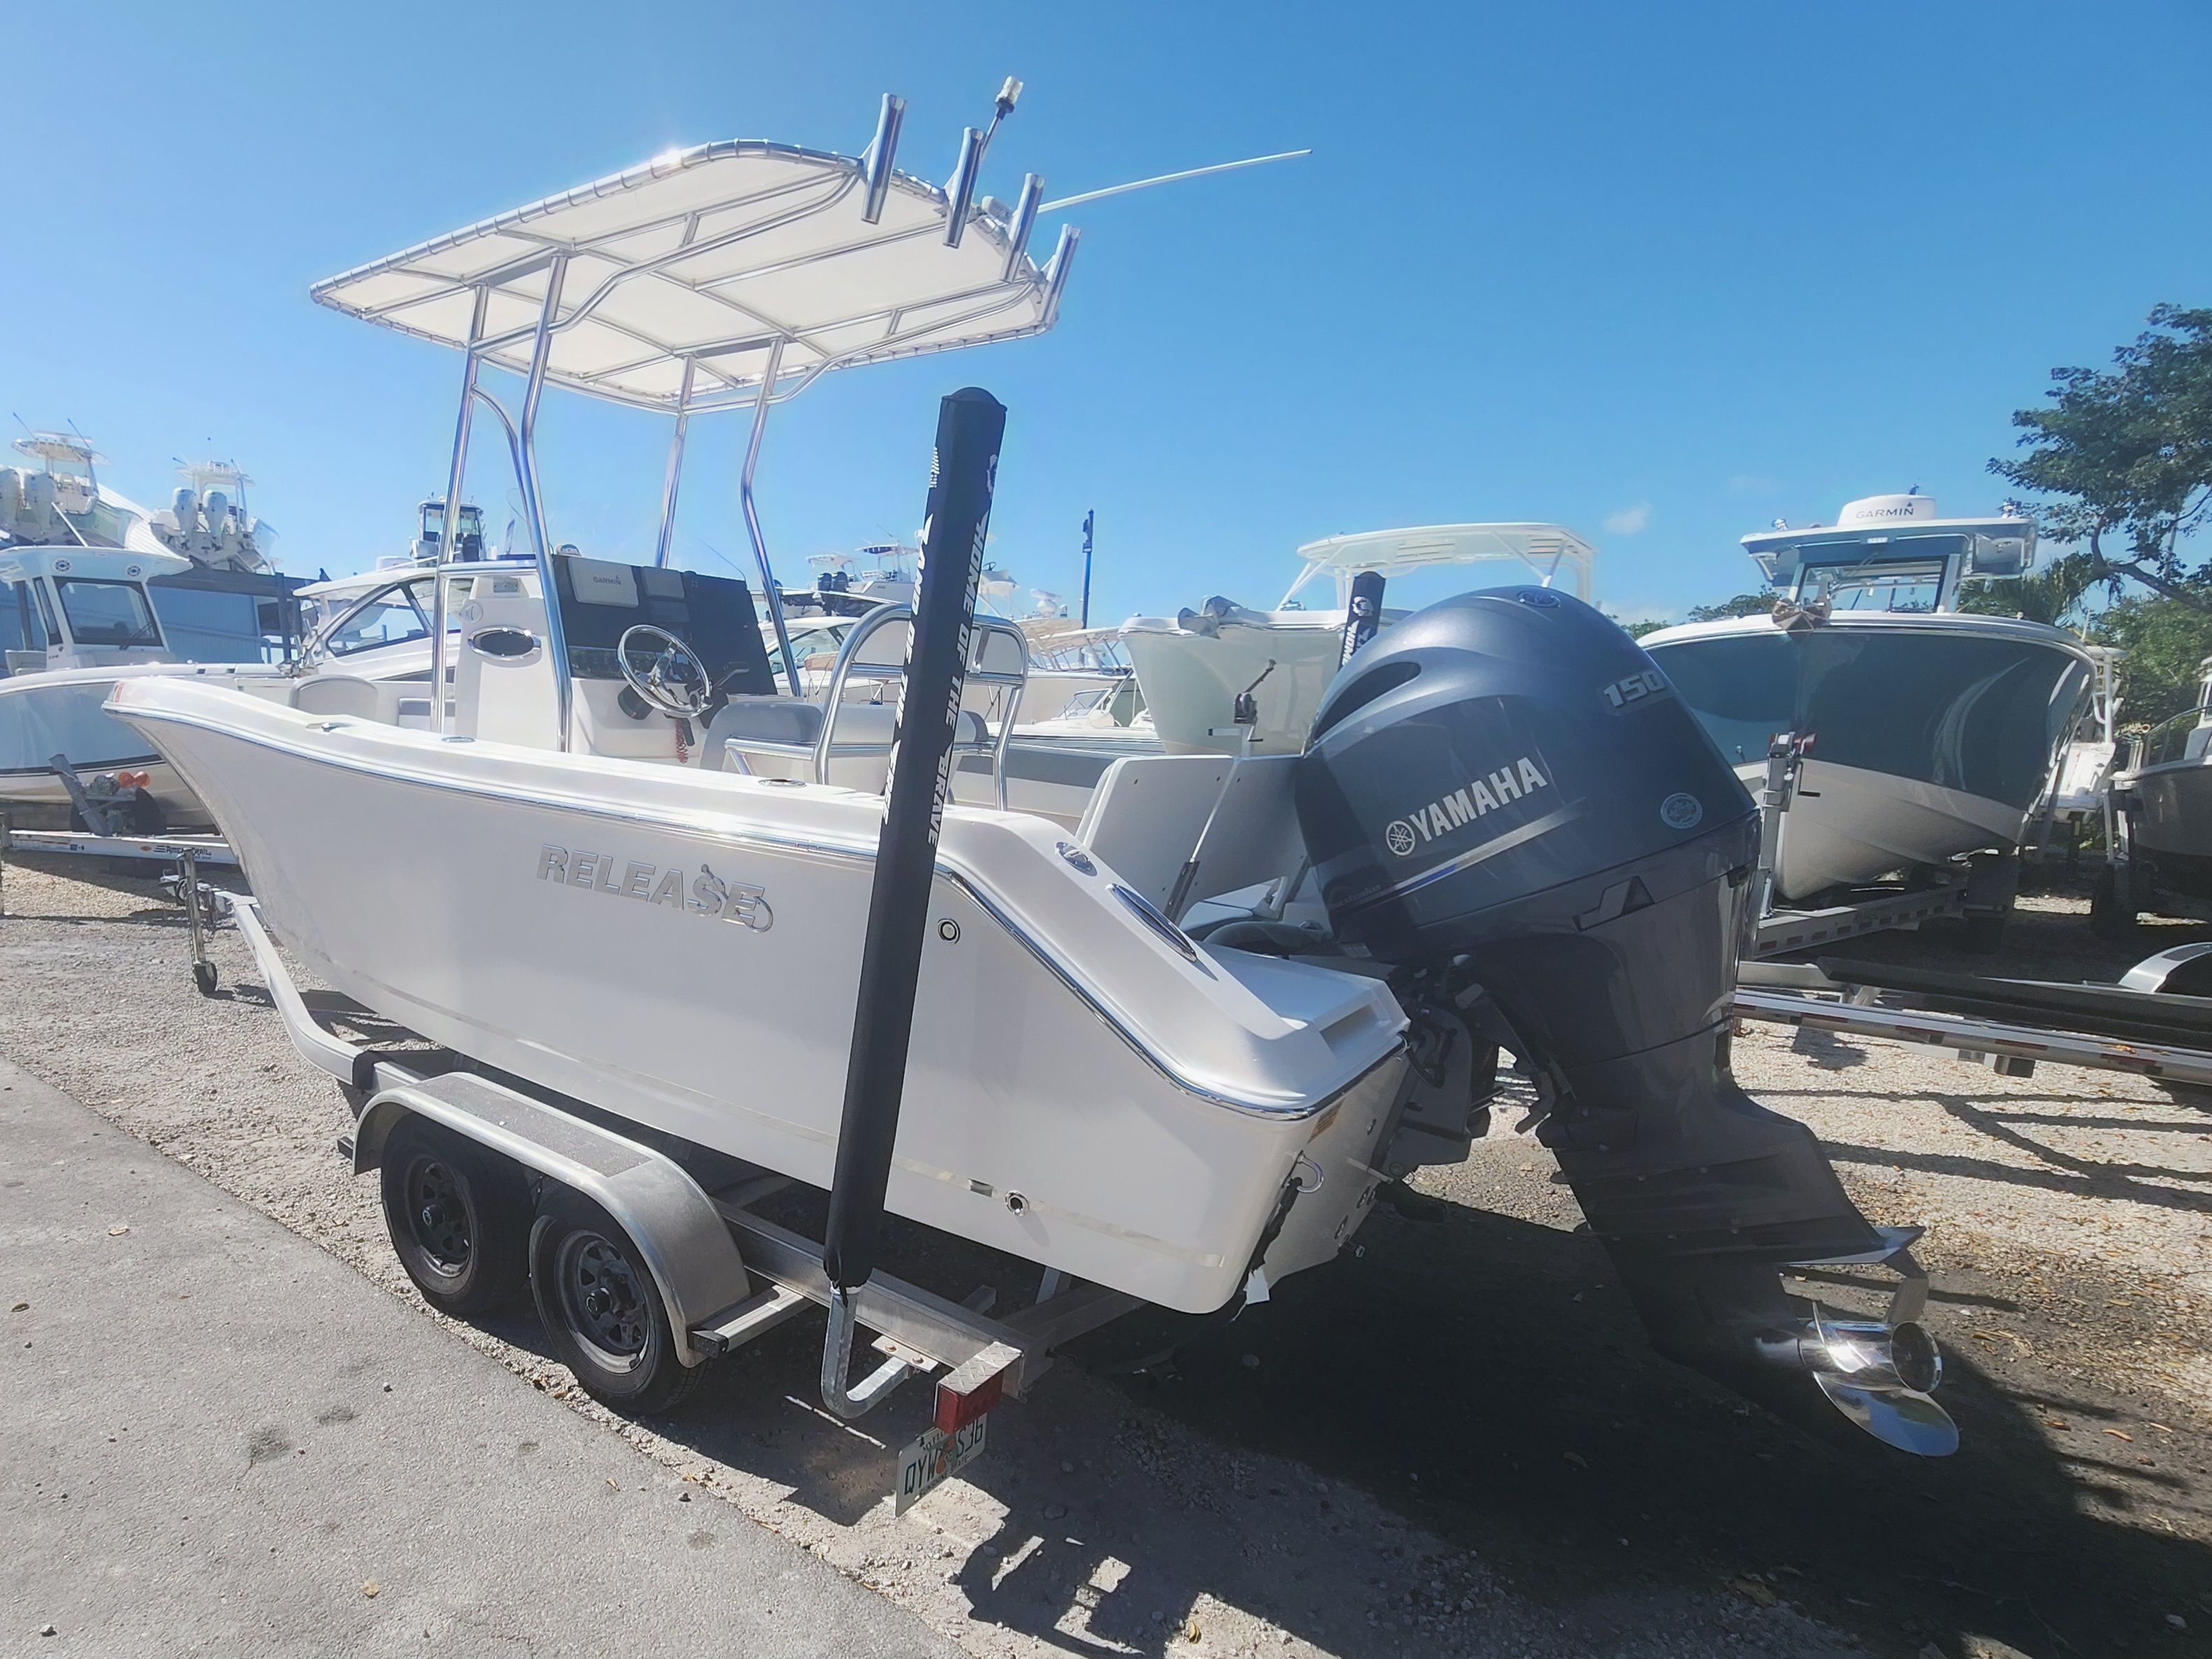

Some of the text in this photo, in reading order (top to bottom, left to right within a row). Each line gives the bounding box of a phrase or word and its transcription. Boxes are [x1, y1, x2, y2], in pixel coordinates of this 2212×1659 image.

[1856, 508, 1914, 519] GARMIN
[592, 577, 621, 585] GARMIN
[905, 620, 915, 665] OF
[896, 669, 908, 729] THE
[928, 509, 990, 846] HOME OF THE BRAVE
[1604, 670, 1666, 707] 150
[883, 739, 901, 825] FREE
[1409, 757, 1548, 842] YAMAHA
[537, 843, 773, 934] RELEASE
